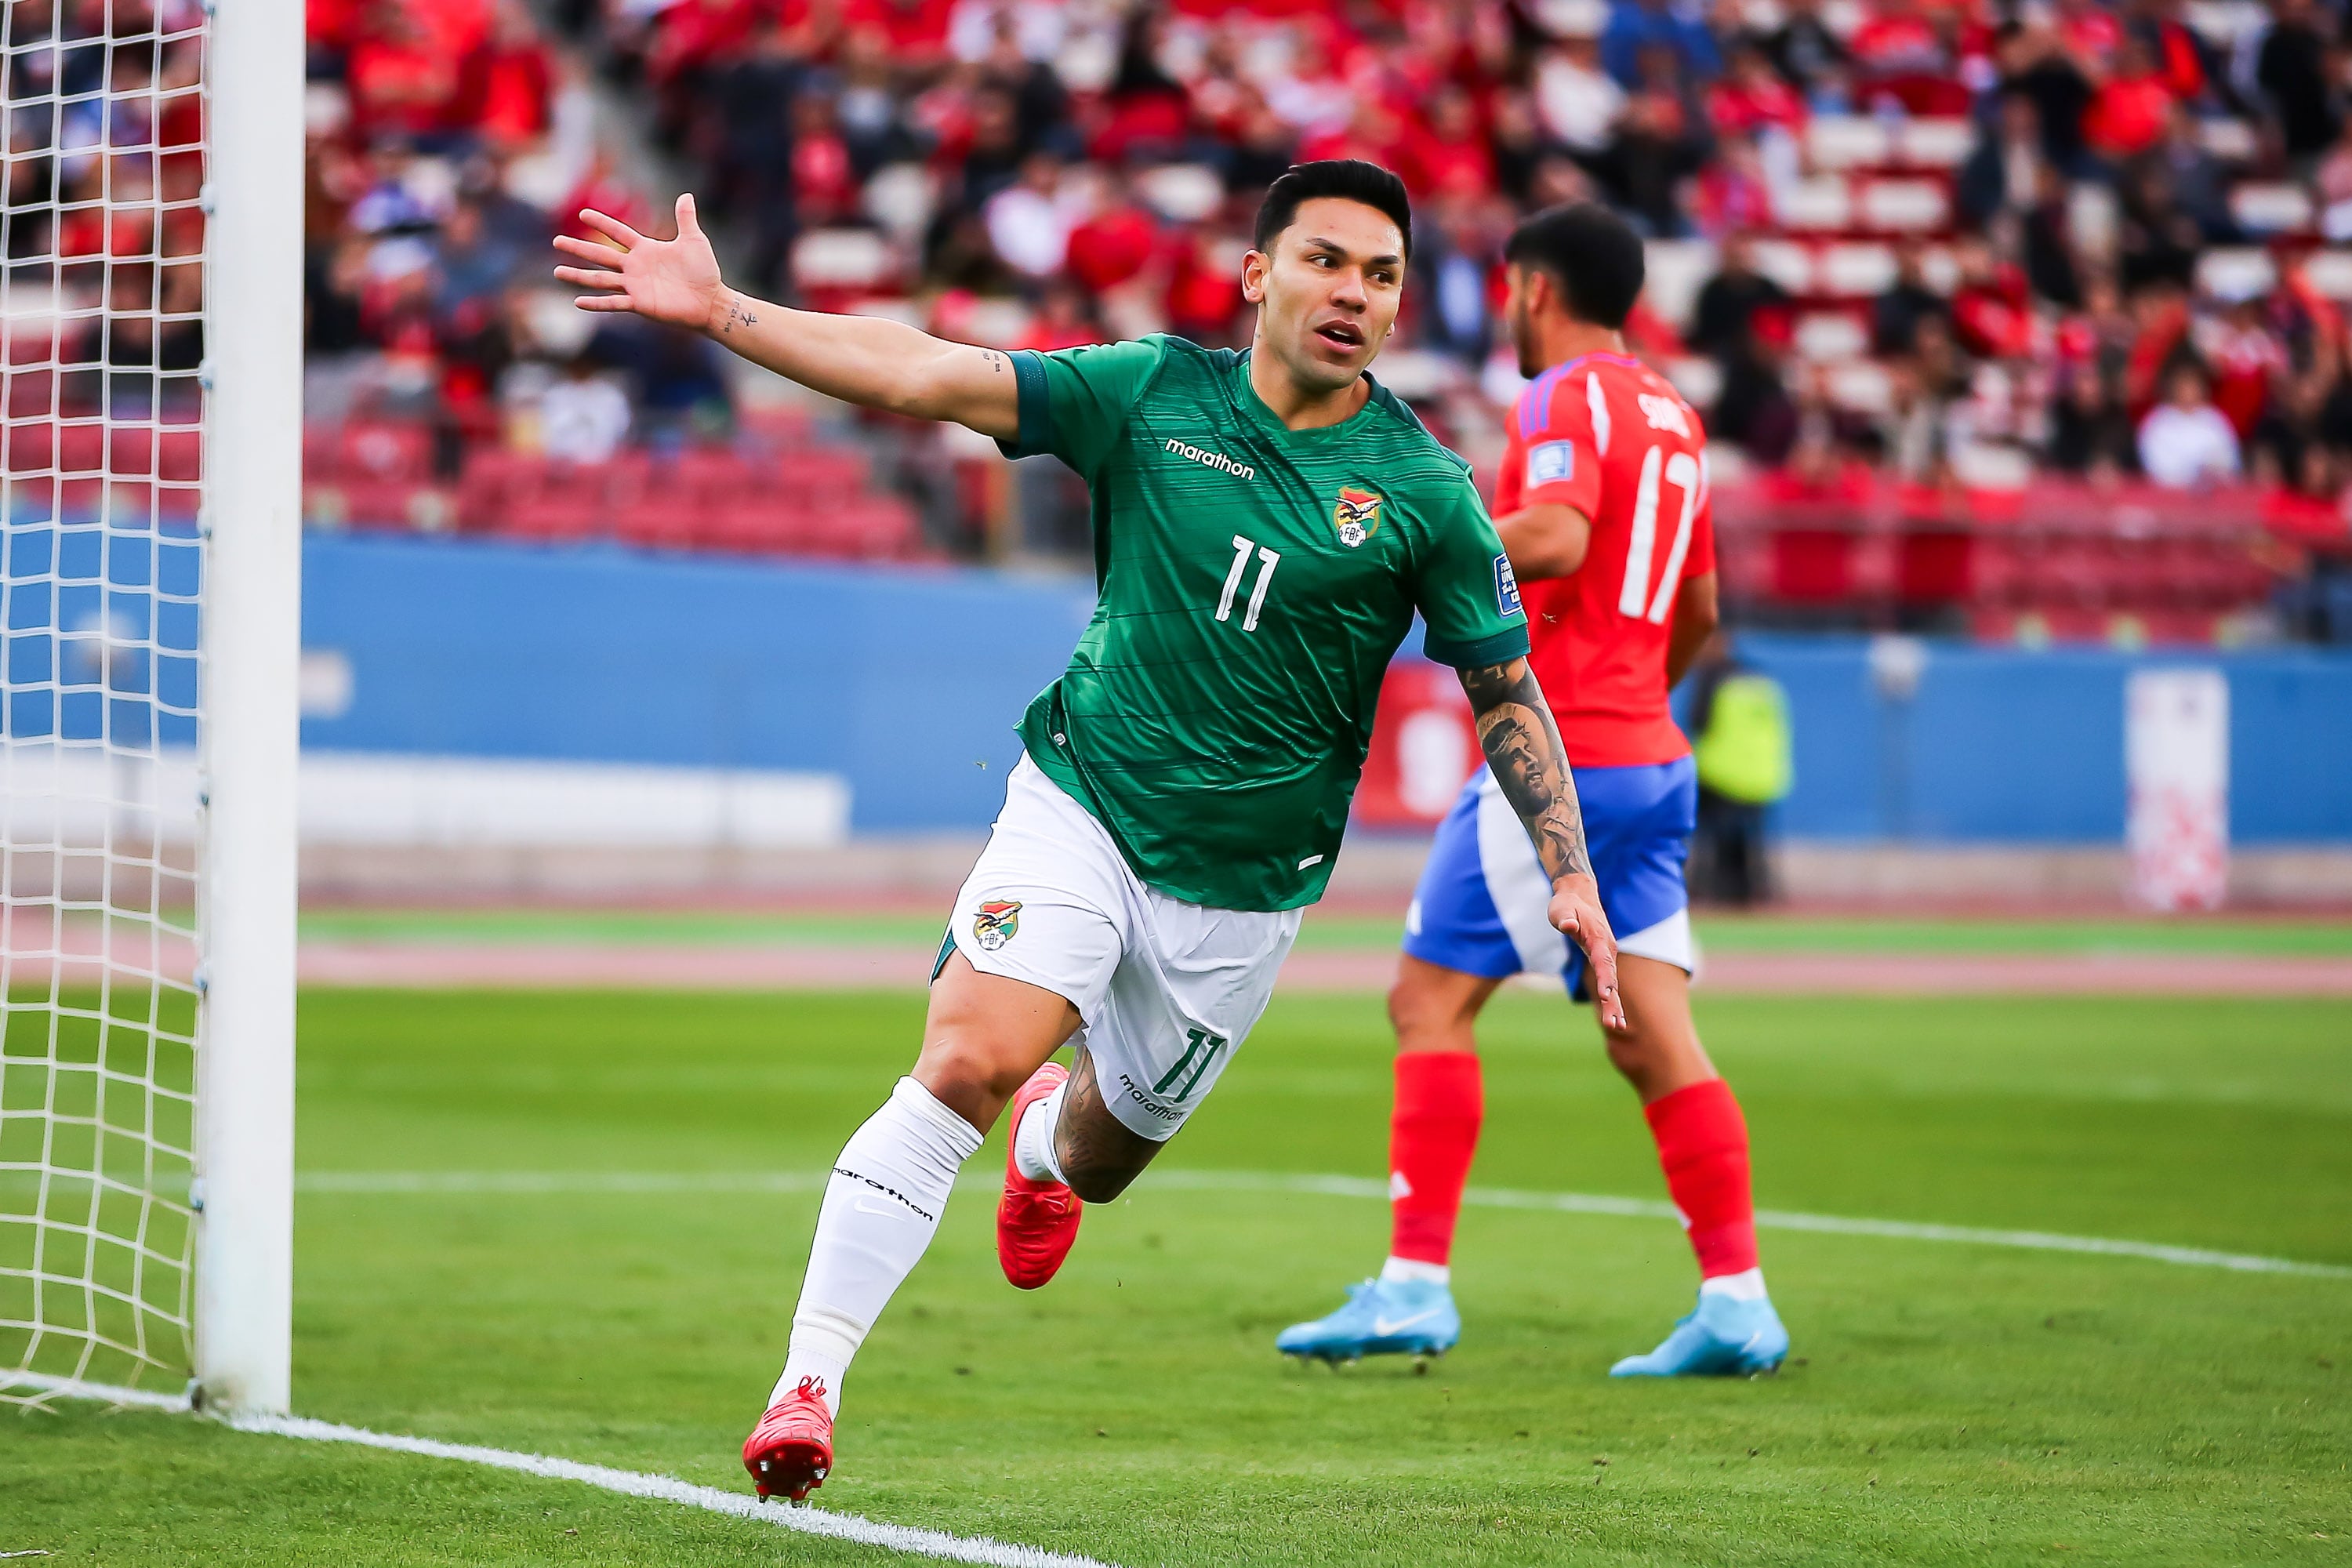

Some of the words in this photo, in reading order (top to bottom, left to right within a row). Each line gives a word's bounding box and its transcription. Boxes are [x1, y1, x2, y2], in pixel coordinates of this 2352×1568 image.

[1164, 437, 1255, 481] marathon
[1344, 527, 1361, 541] FBF
[1617, 444, 1700, 625] 17
[1214, 533, 1281, 632] 11
[984, 933, 1000, 945] FBF
[1152, 1027, 1228, 1104] 11
[1119, 1073, 1185, 1121] marathon
